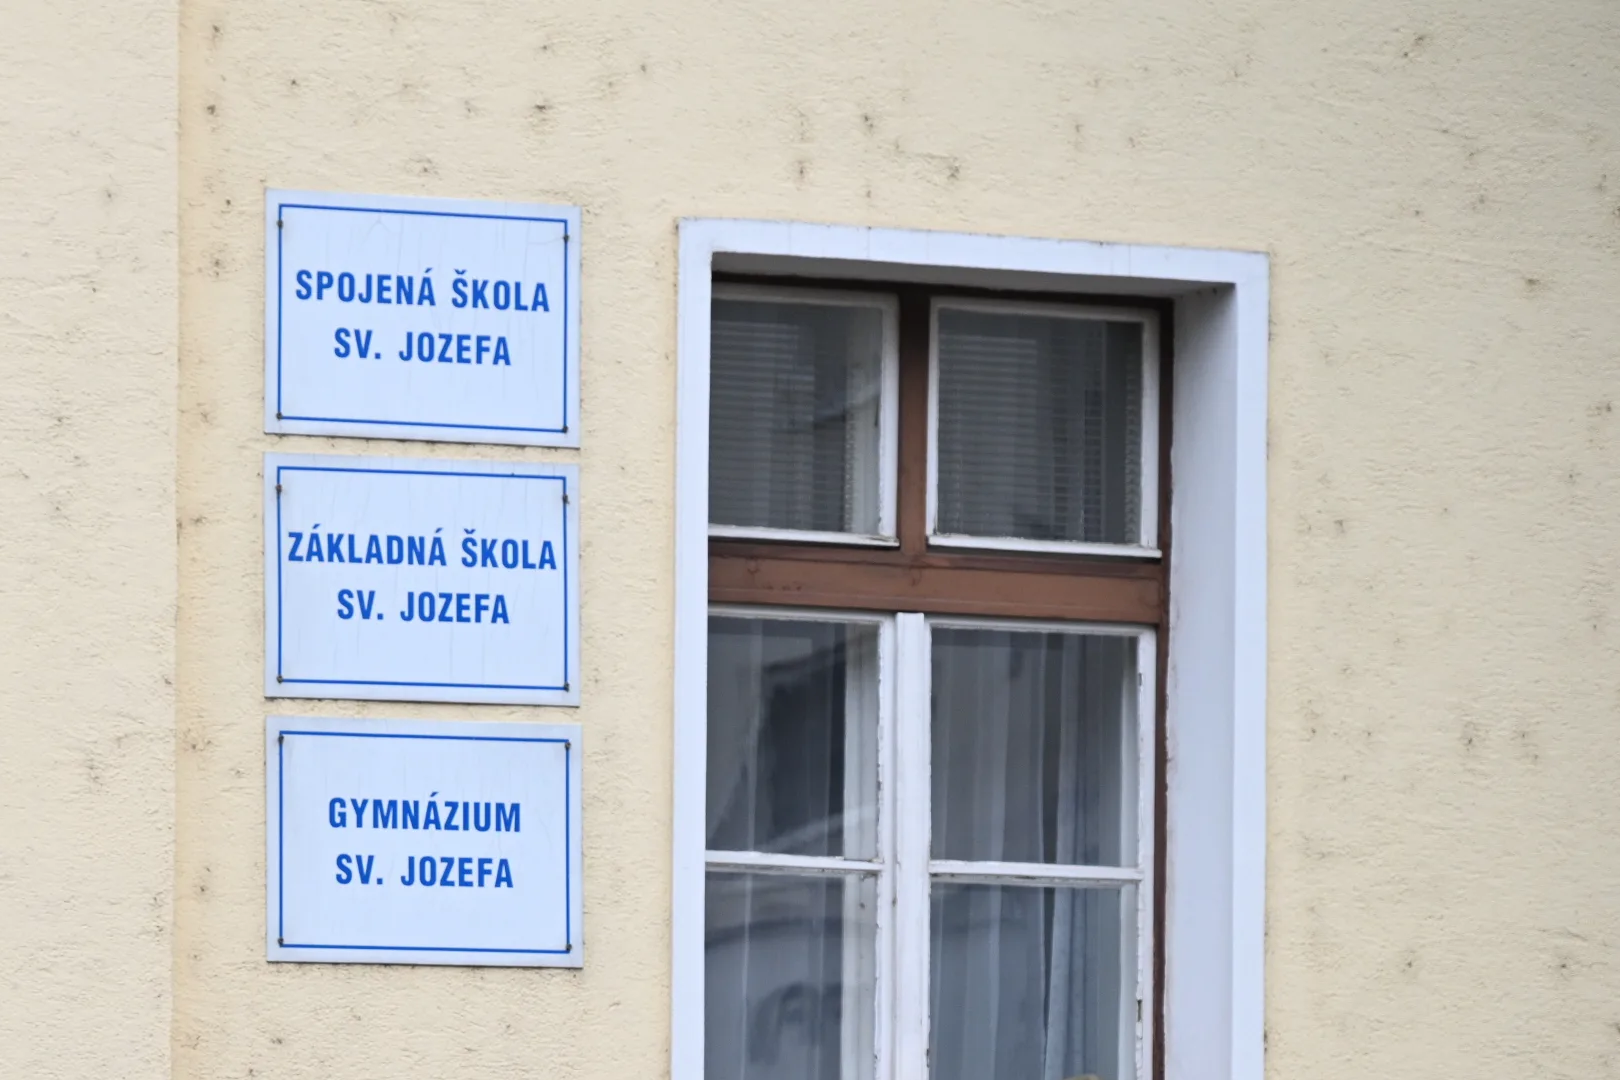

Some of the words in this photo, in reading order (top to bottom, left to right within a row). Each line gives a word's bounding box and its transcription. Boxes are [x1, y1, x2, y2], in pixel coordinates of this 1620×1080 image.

[296, 268, 436, 306] SPOJENÁ
[452, 269, 550, 312] ŠKOLA
[334, 328, 381, 359] SV.
[399, 332, 511, 366] JOZEFA
[288, 524, 447, 566] ZÁKLADNÁ
[461, 528, 557, 570] ŠKOLA
[337, 589, 384, 620] SV.
[400, 592, 510, 624] JOZEFA
[329, 792, 521, 832] GYMNÁZIUM
[336, 854, 383, 885] SV.
[401, 856, 514, 888] JOZEFA
